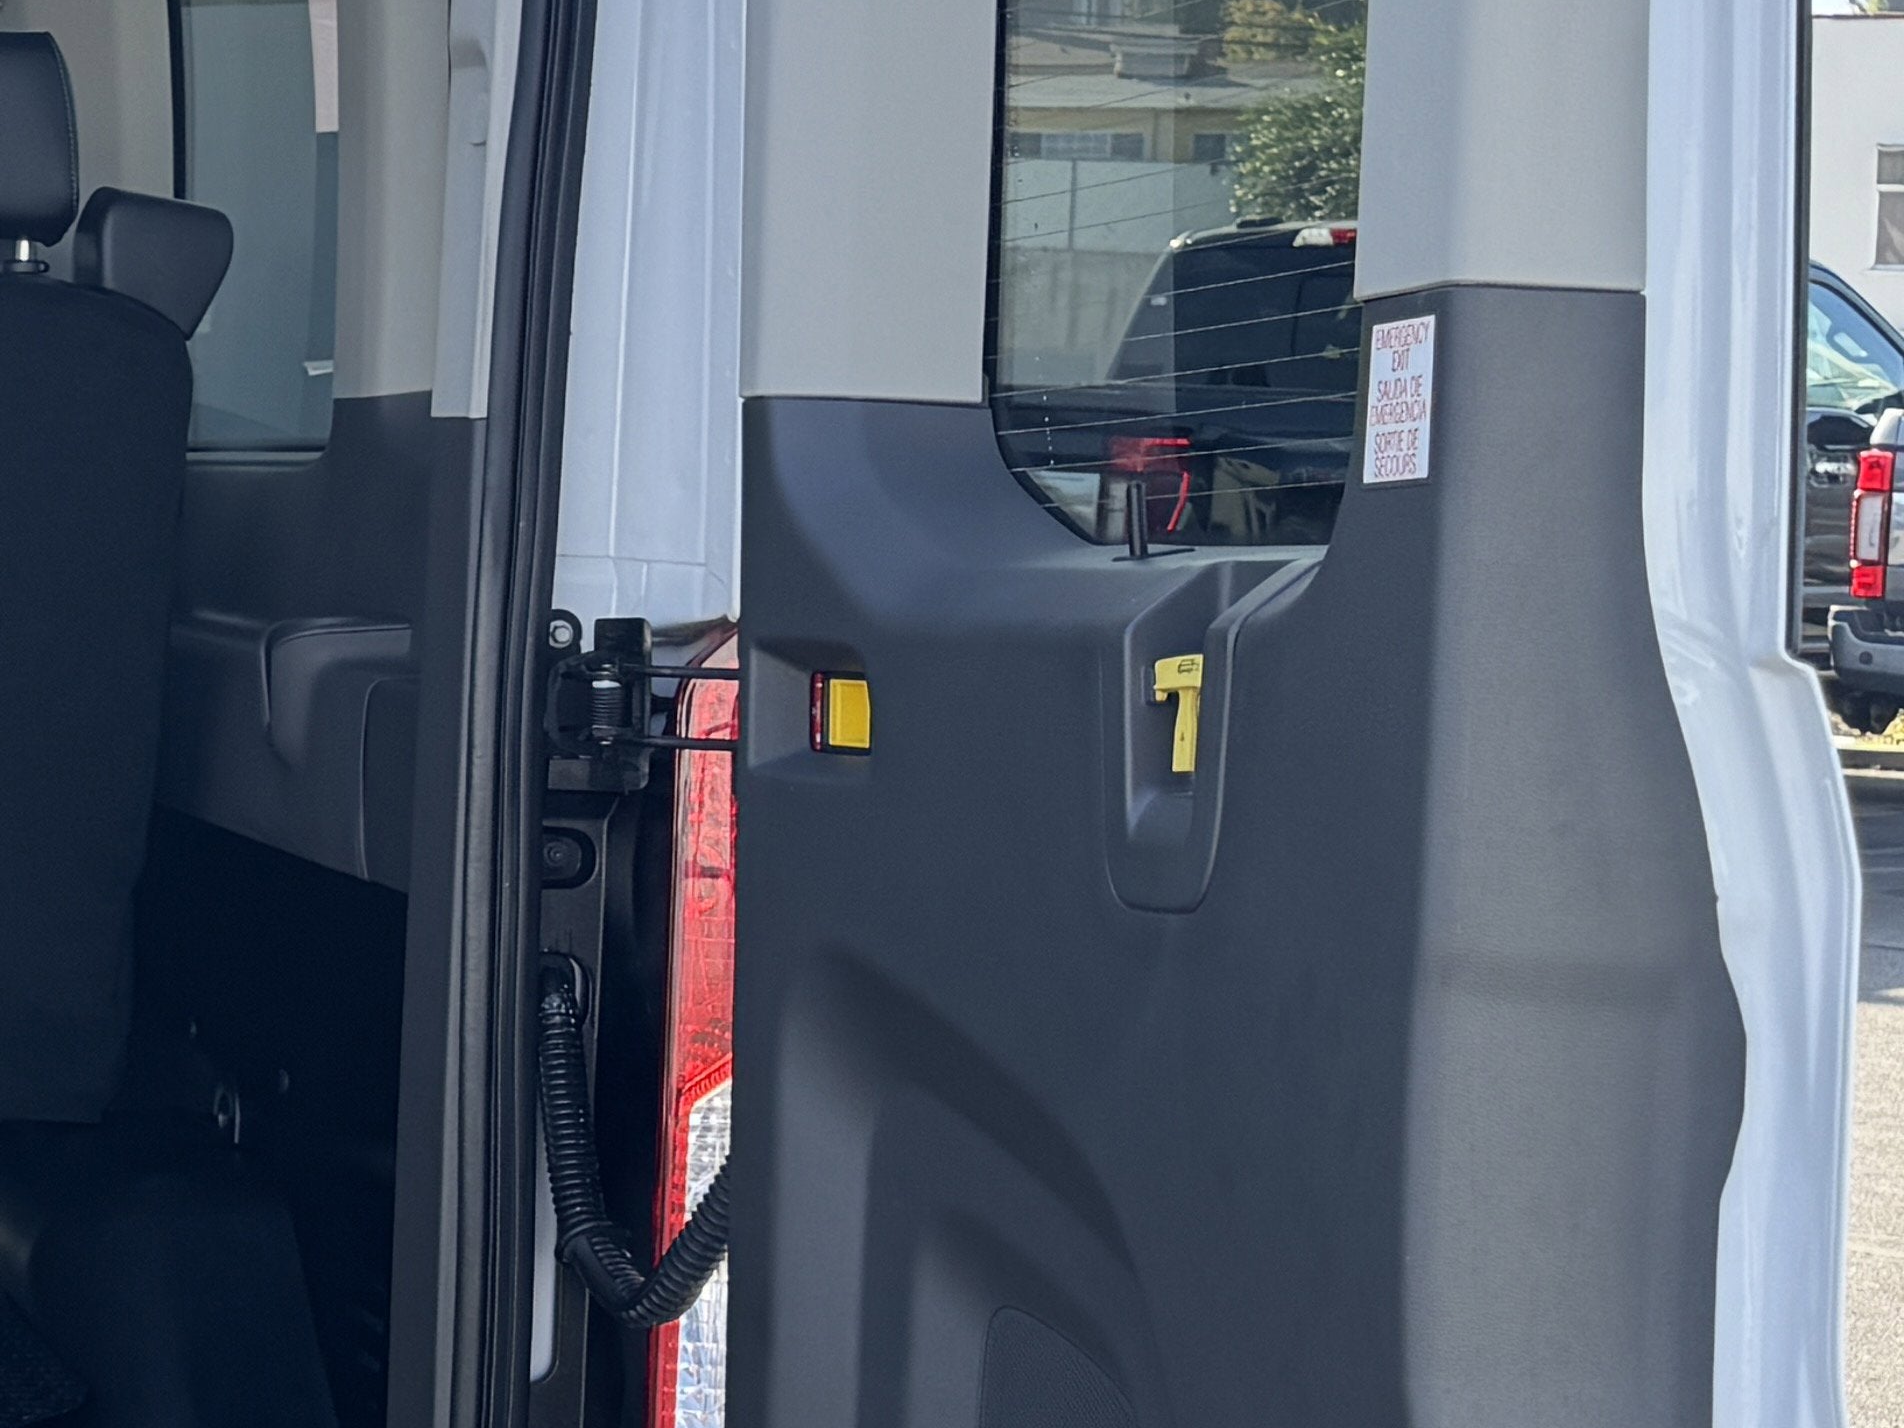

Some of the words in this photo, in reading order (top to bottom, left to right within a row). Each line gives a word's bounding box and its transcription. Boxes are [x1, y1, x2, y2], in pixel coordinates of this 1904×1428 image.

[1376, 321, 1430, 350] EMERGENCY
[1392, 348, 1410, 372] EXIT
[1377, 377, 1408, 402] SALIDA
[1410, 375, 1423, 398] DE
[1369, 399, 1427, 426] EMERGENCIA
[1374, 430, 1404, 455] SORTIE
[1407, 428, 1419, 451] DE
[1374, 453, 1417, 478] SECOURS
